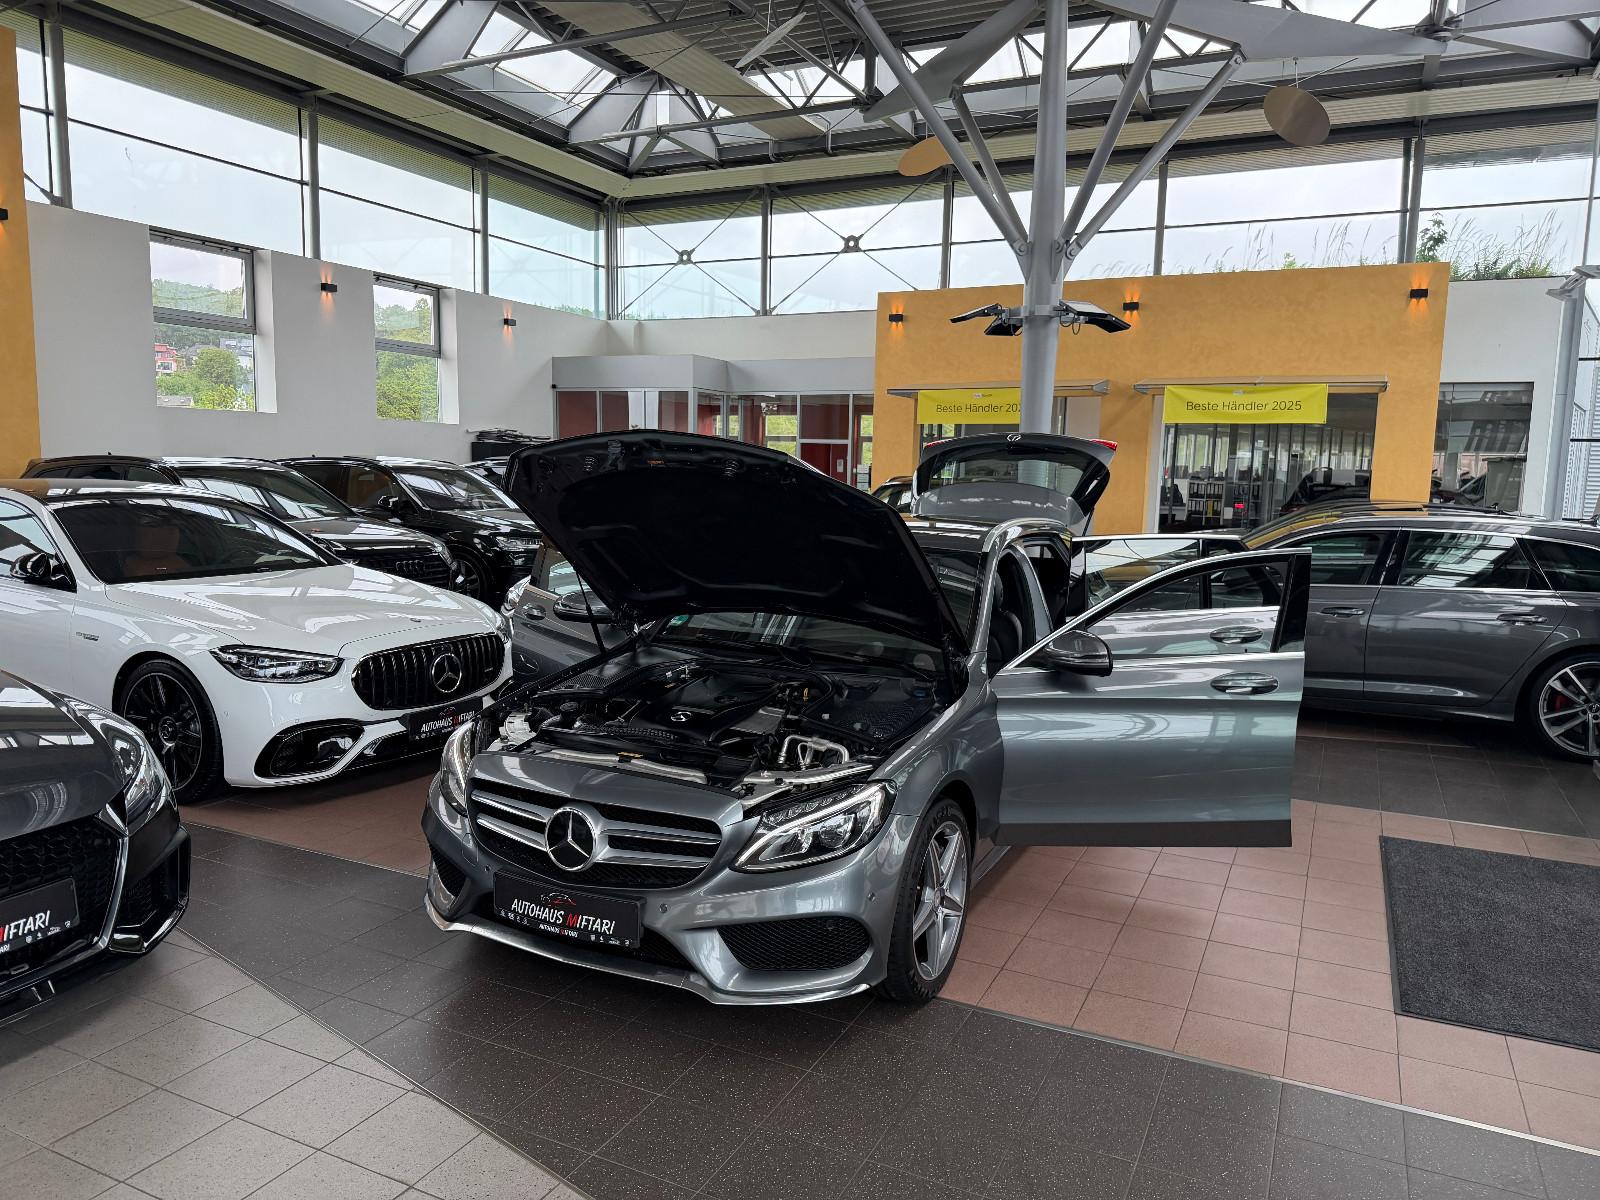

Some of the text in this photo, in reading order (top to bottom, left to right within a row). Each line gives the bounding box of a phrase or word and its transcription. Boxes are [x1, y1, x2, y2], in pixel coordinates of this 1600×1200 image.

[936, 403, 1021, 413] Beste Händler 20
[1186, 400, 1302, 411] Beste Händler 2025
[421, 717, 453, 733] AUTOHAUS
[511, 899, 616, 935] AUTOHAUS MIFTARI
